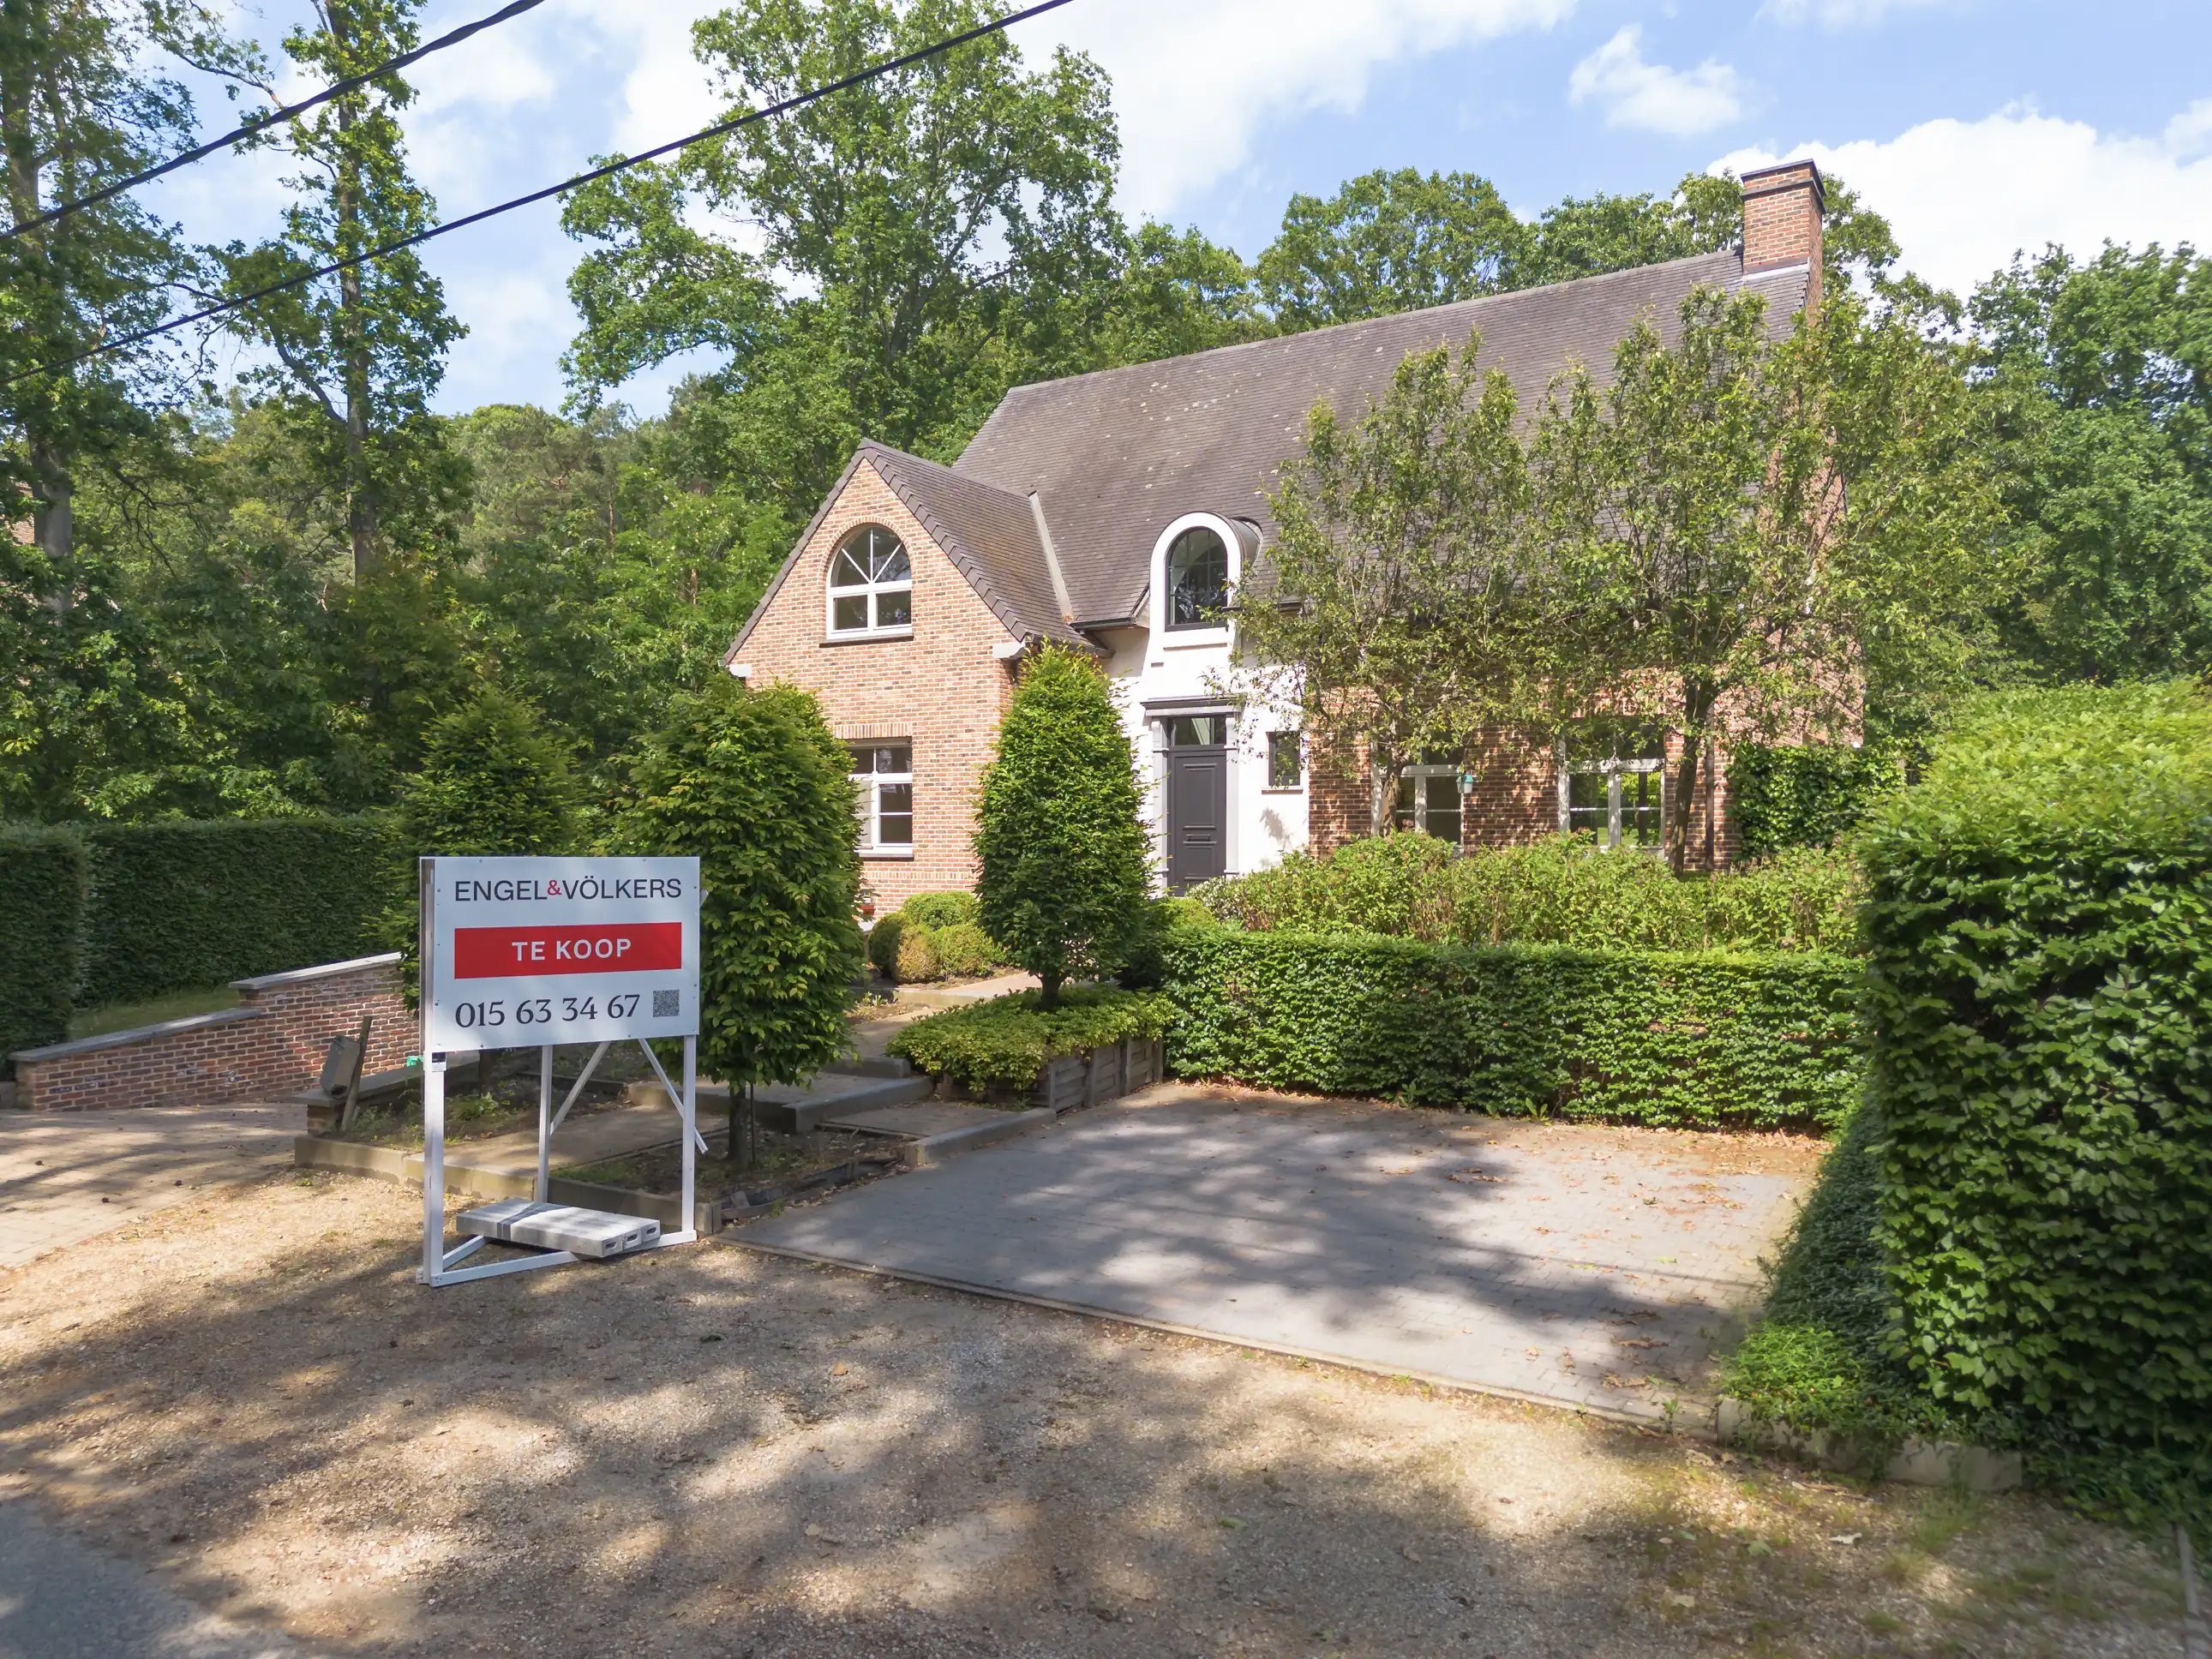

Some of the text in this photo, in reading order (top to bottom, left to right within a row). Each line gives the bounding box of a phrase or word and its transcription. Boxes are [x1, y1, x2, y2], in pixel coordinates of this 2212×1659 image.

[454, 876, 682, 901] ENGEL&VÖLKERS
[512, 938, 632, 961] TE KOOP
[455, 994, 640, 1027] 015 63 34 67
